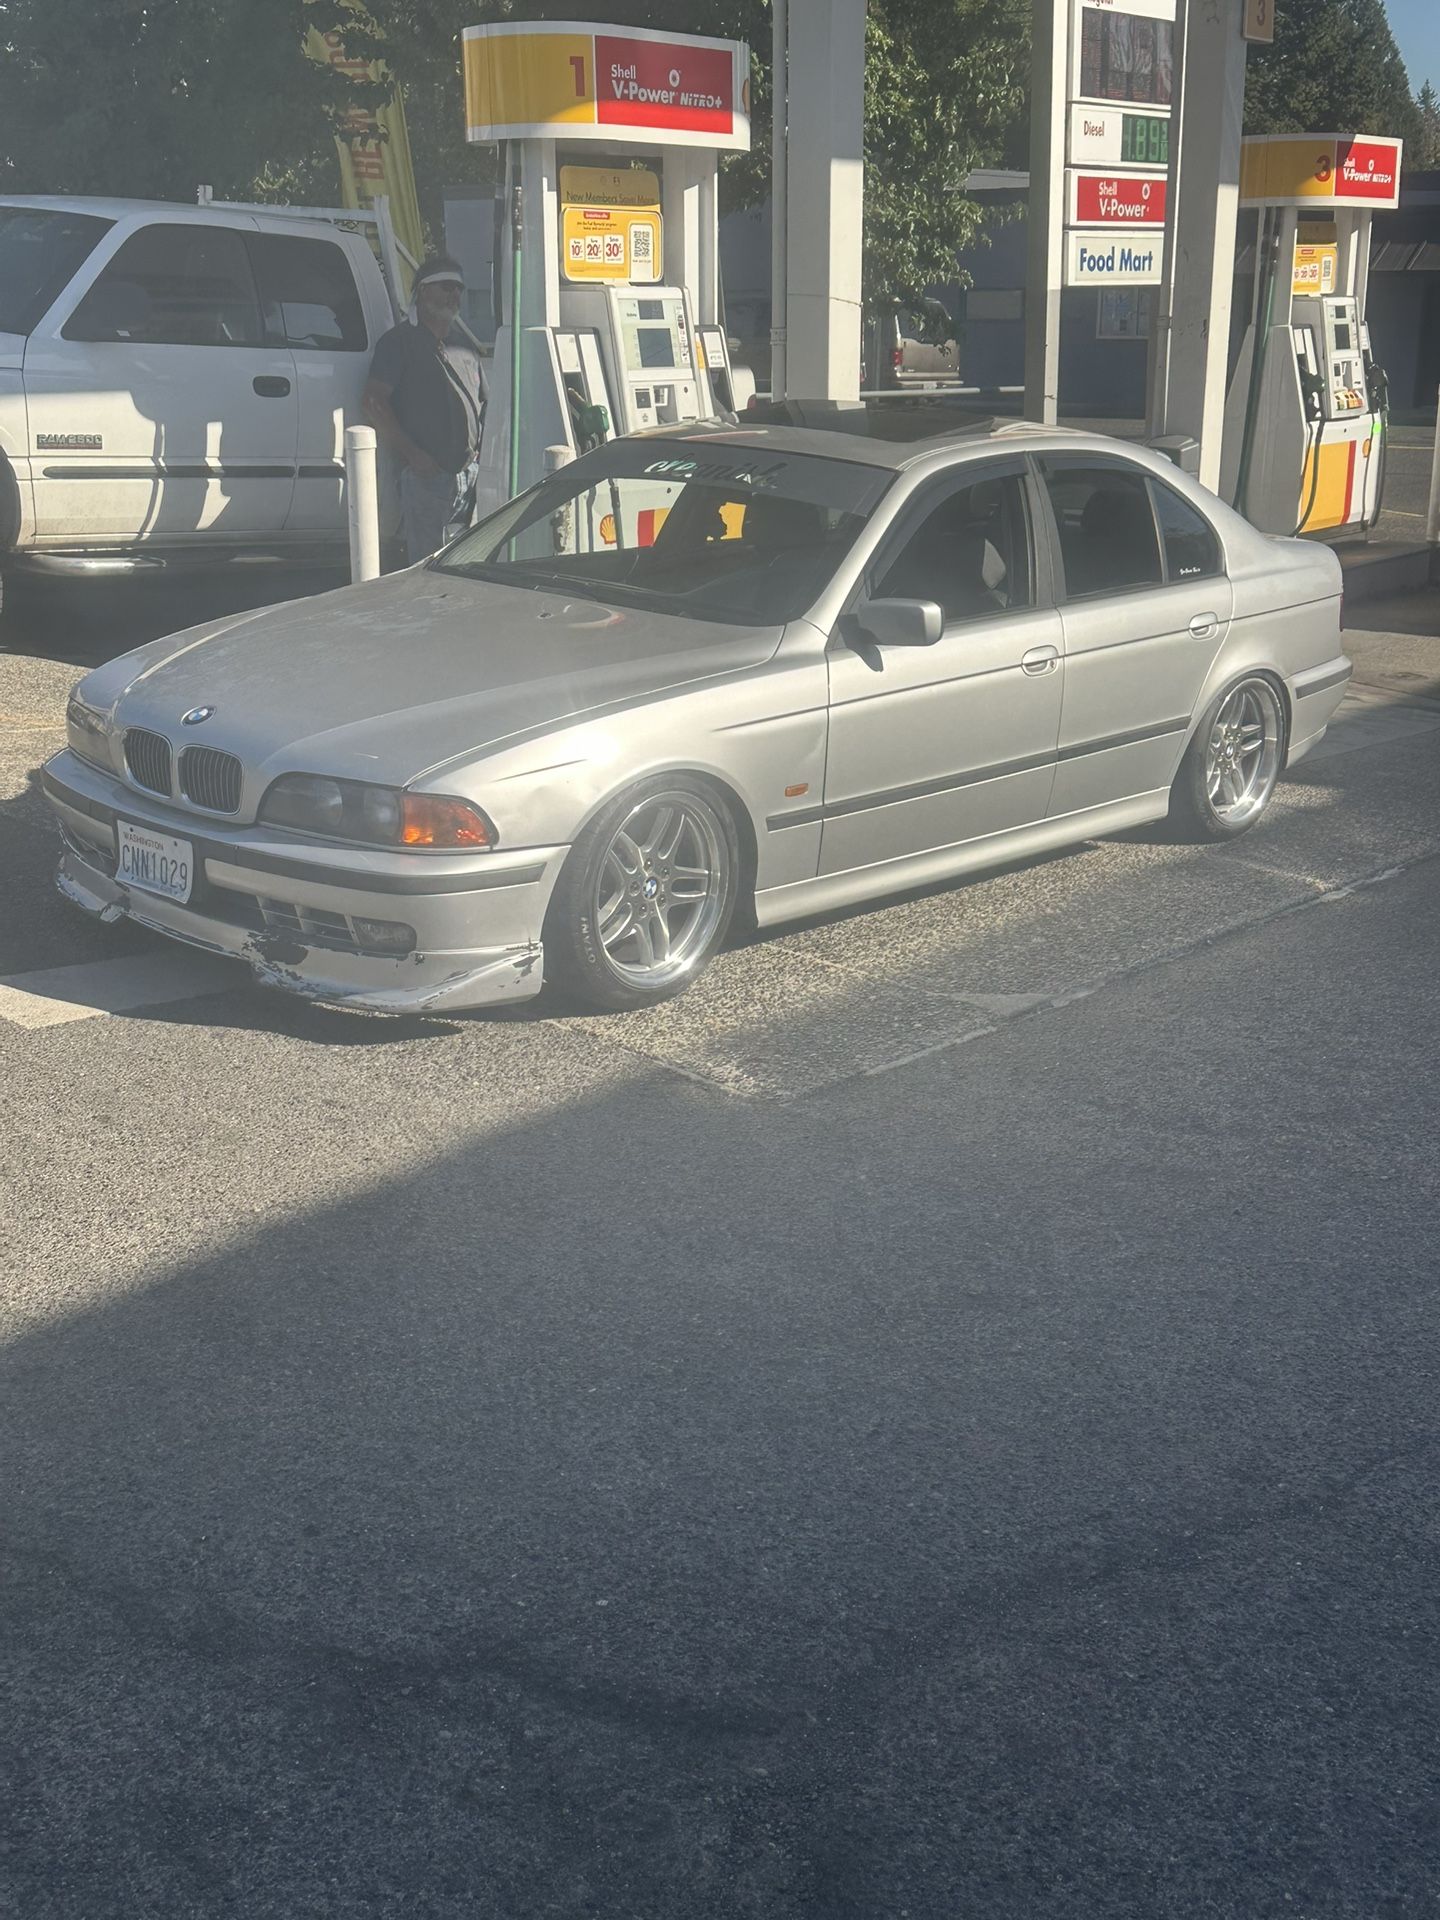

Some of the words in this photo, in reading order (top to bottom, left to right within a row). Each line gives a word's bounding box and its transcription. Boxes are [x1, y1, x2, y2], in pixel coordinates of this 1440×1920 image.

[569, 56, 585, 97] 1
[611, 64, 636, 79] Shell
[611, 80, 675, 104] V-Power
[1083, 120, 1105, 136] Diesel
[1314, 155, 1331, 182] 3
[1098, 180, 1117, 196] Shell
[1098, 198, 1146, 217] V-Power
[1079, 246, 1115, 272] Food
[1119, 248, 1153, 272] Mart
[123, 831, 164, 851] WASHINGTON
[122, 844, 188, 892] CNN1029
